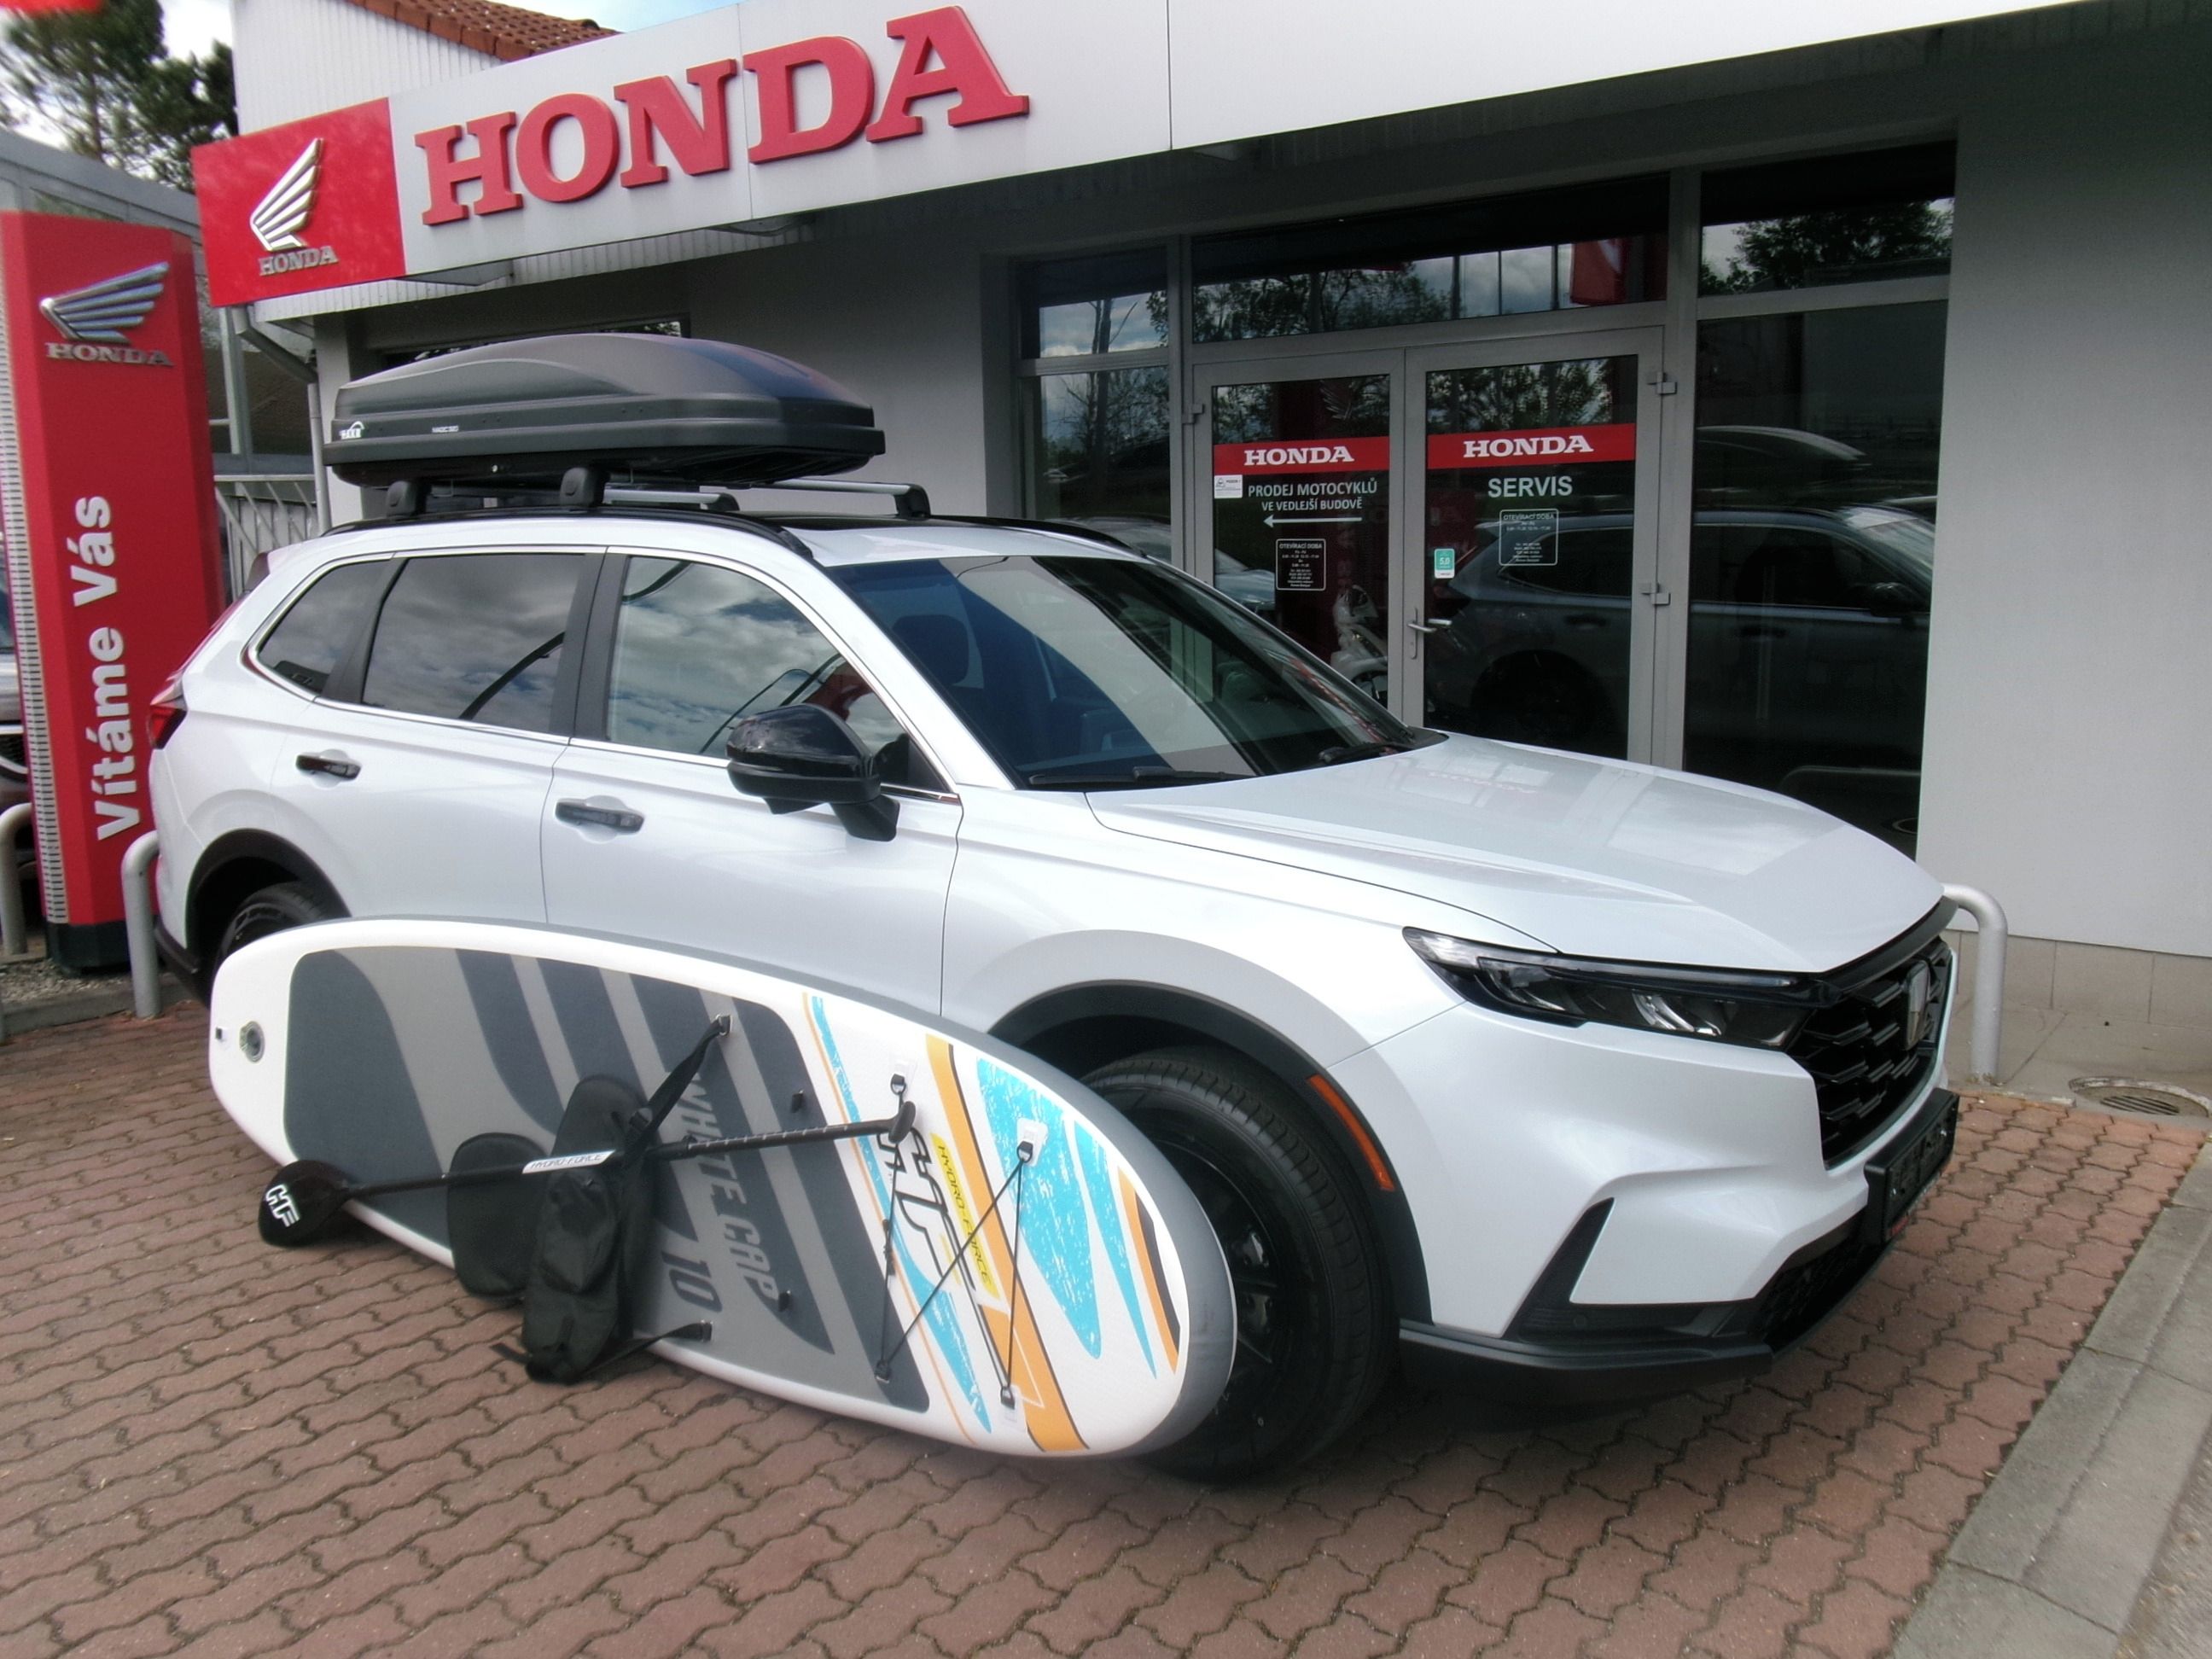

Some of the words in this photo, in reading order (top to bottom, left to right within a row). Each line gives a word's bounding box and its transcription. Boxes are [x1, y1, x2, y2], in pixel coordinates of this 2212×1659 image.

[414, 5, 1030, 226] HONDA
[258, 245, 339, 276] HONDA
[44, 341, 175, 367] HONDA
[1243, 445, 1354, 466] HONDA
[1463, 435, 1594, 458] HONDA
[1248, 484, 1294, 498] PRODEJ
[1297, 477, 1377, 496] MOTOCYKLŮ
[1487, 475, 1573, 498] SERVIS
[1261, 501, 1274, 511] VE
[1276, 498, 1318, 511] VEDLEJŠÍ
[1320, 497, 1363, 510] BUDOVĚ
[67, 496, 119, 607] Vás
[86, 626, 141, 841] Vítáme
[719, 1214, 780, 1301] CAP
[661, 1250, 723, 1313] 10
